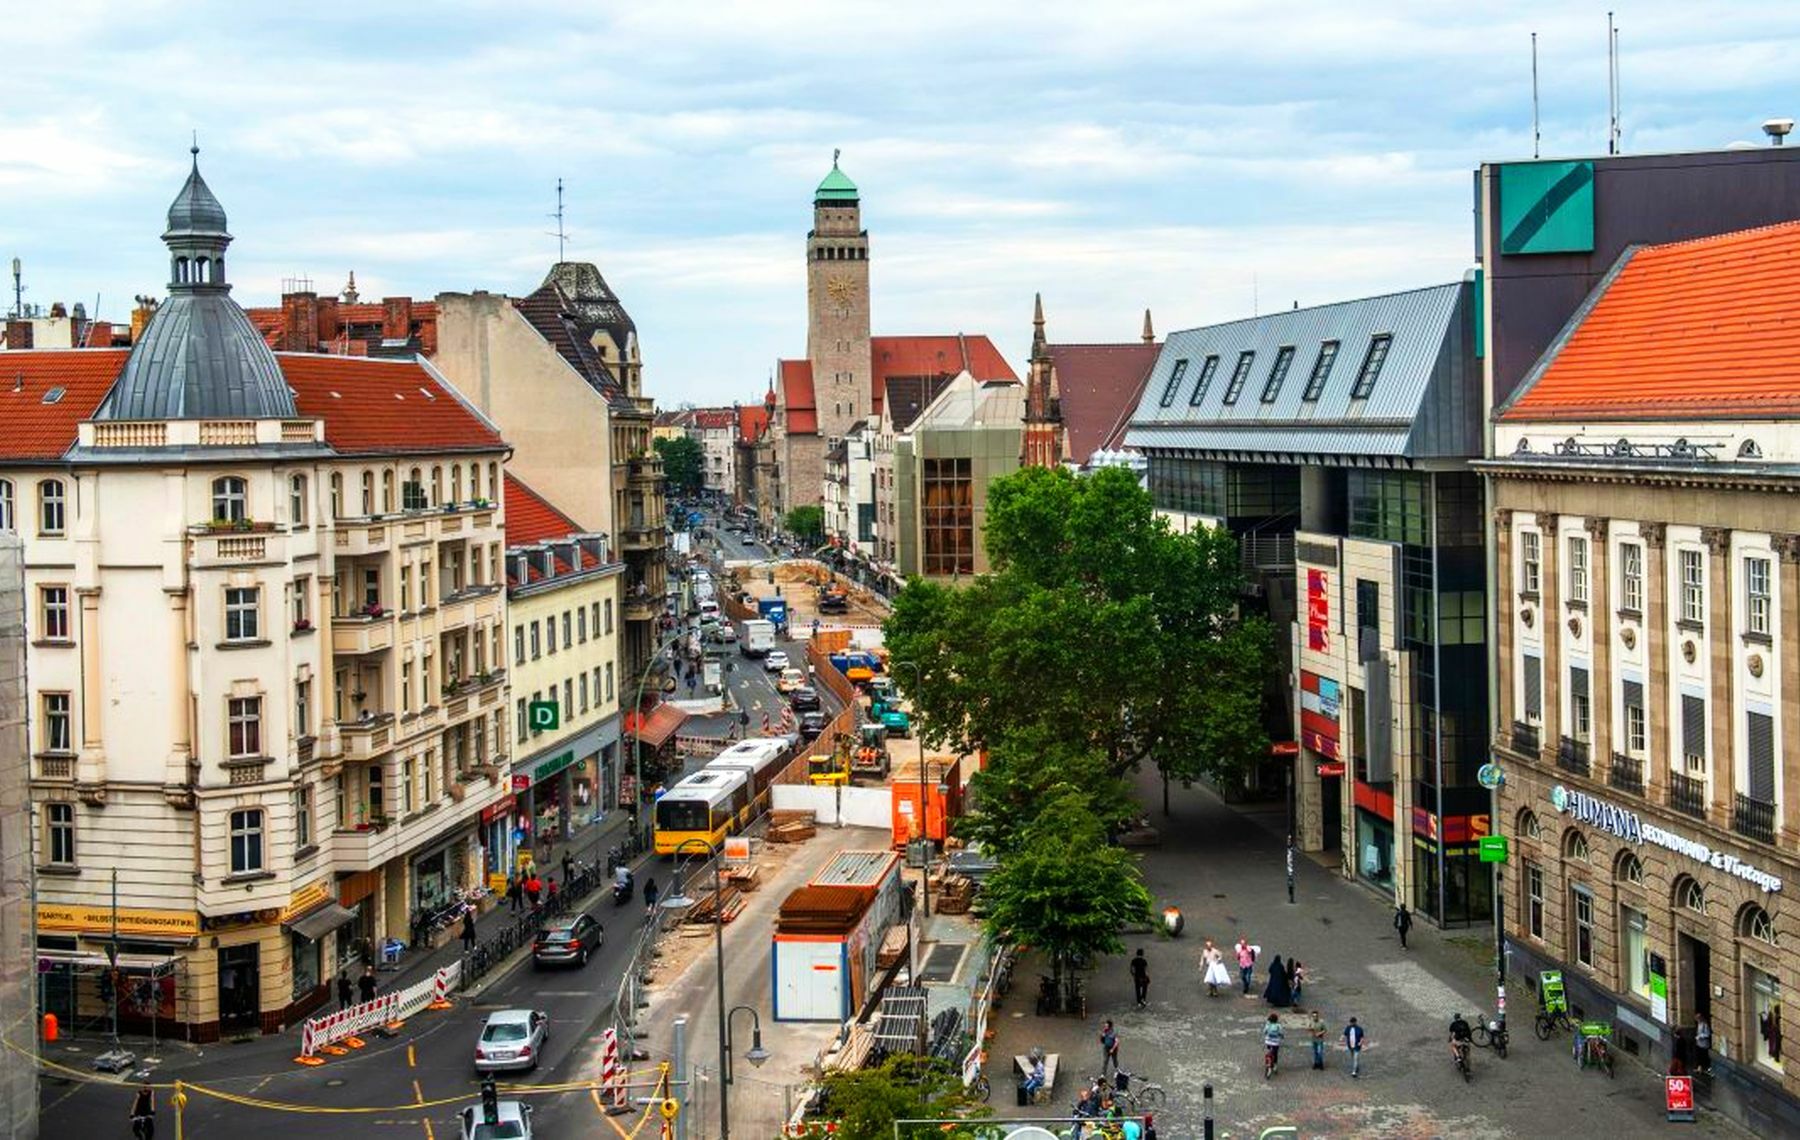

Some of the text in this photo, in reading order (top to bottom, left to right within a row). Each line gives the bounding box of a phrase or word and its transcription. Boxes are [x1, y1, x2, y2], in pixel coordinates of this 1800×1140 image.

[535, 707, 553, 725] D
[1567, 789, 1784, 893] HUMANA SECONDHAND & Vintage
